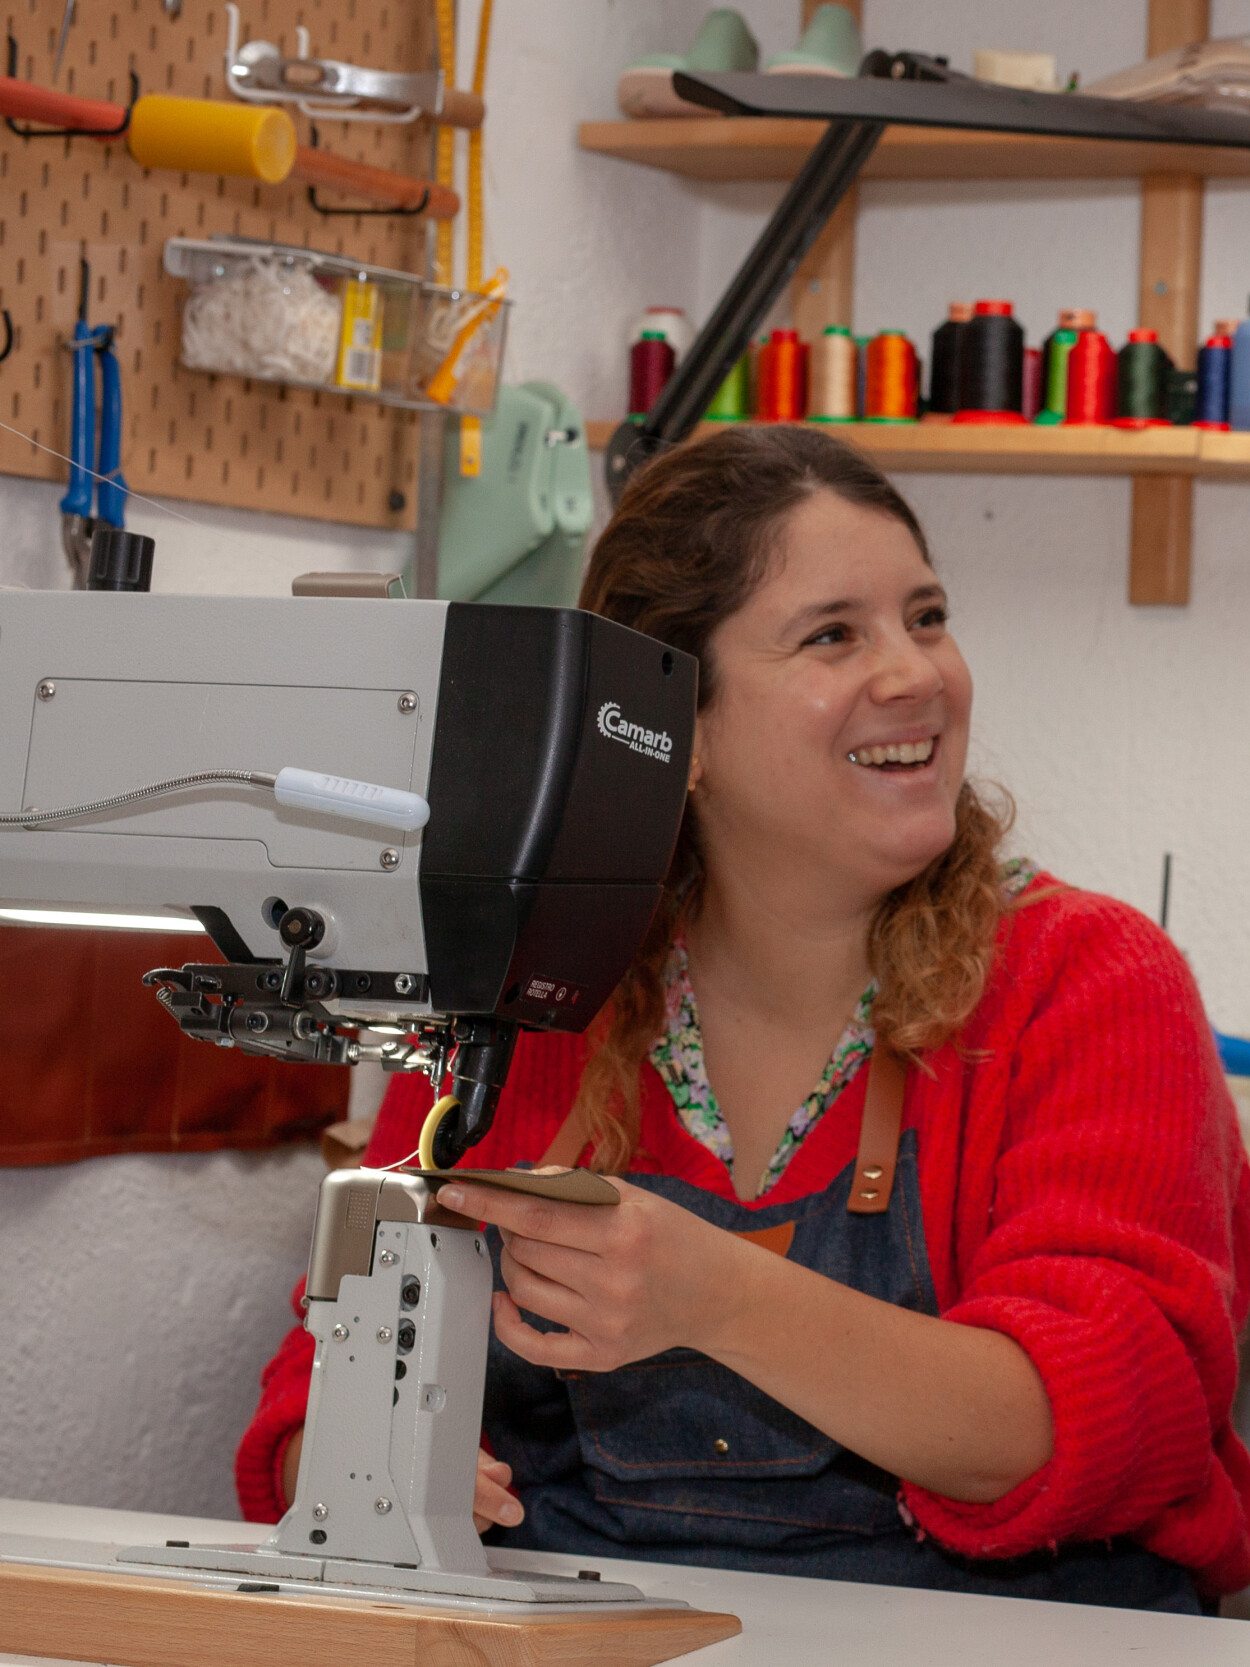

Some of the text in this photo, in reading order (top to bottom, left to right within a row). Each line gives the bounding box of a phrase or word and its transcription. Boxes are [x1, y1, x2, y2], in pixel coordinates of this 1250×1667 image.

[604, 709, 673, 753] Camarb
[628, 741, 671, 763] ALL-IN-ONE
[527, 987, 548, 999] ROTELLA
[530, 979, 555, 992] REGISTRO
